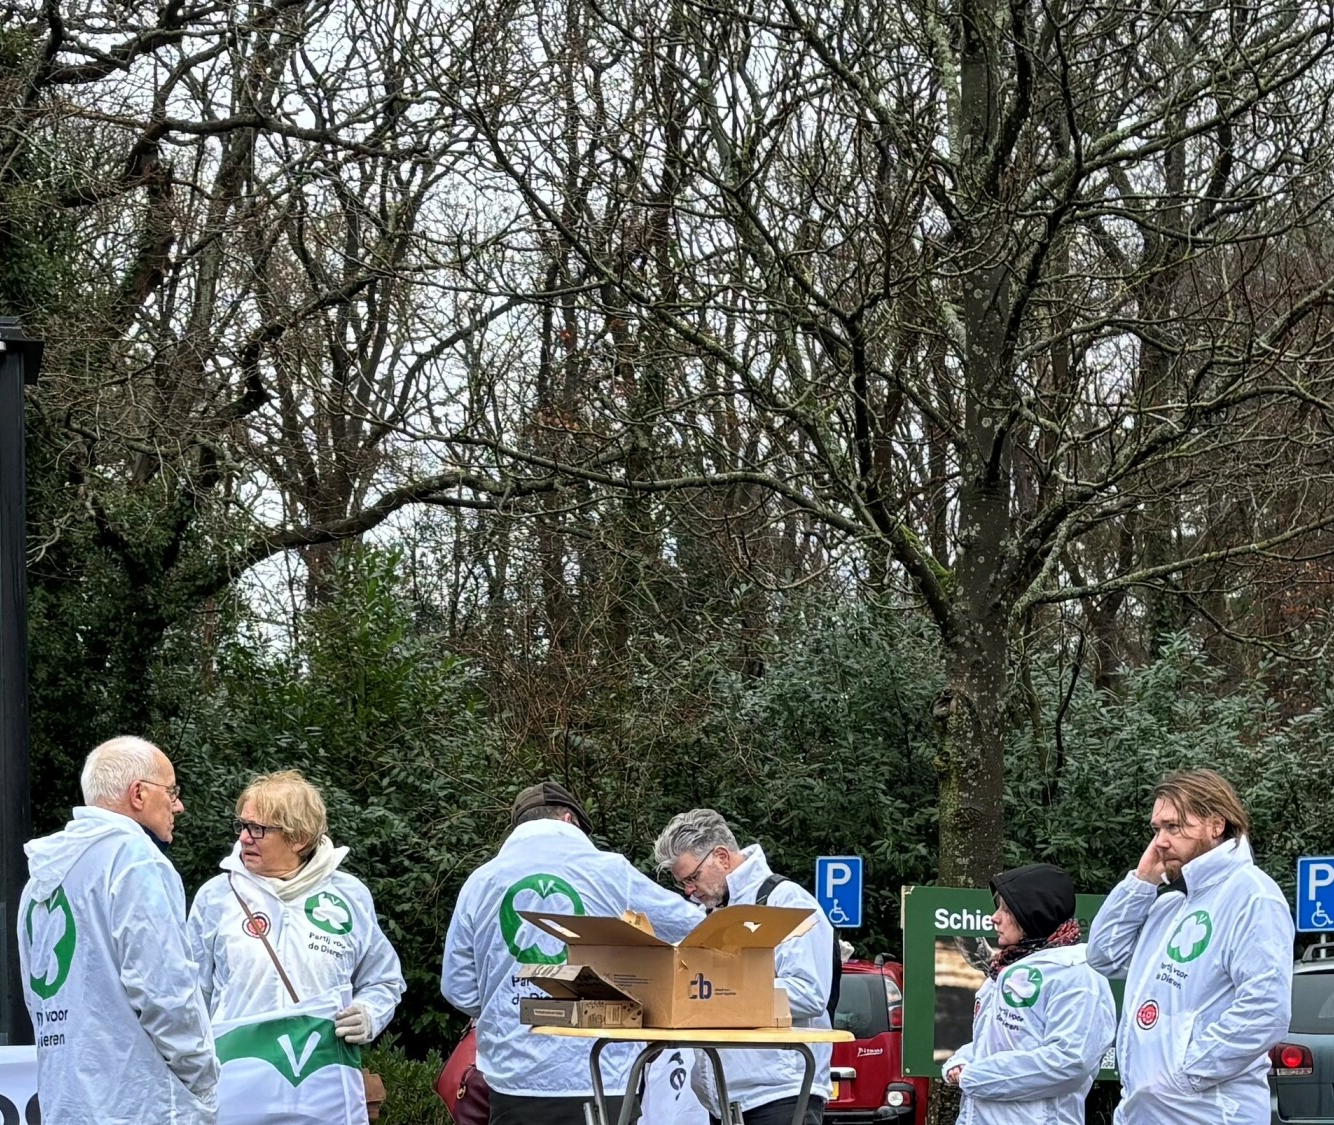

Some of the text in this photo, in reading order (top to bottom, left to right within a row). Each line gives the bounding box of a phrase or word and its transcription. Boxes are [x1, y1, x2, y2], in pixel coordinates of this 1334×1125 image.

[827, 863, 852, 898] P
[934, 908, 999, 931] Schie
[45, 1009, 69, 1022] voor
[38, 1031, 66, 1048] ieren
